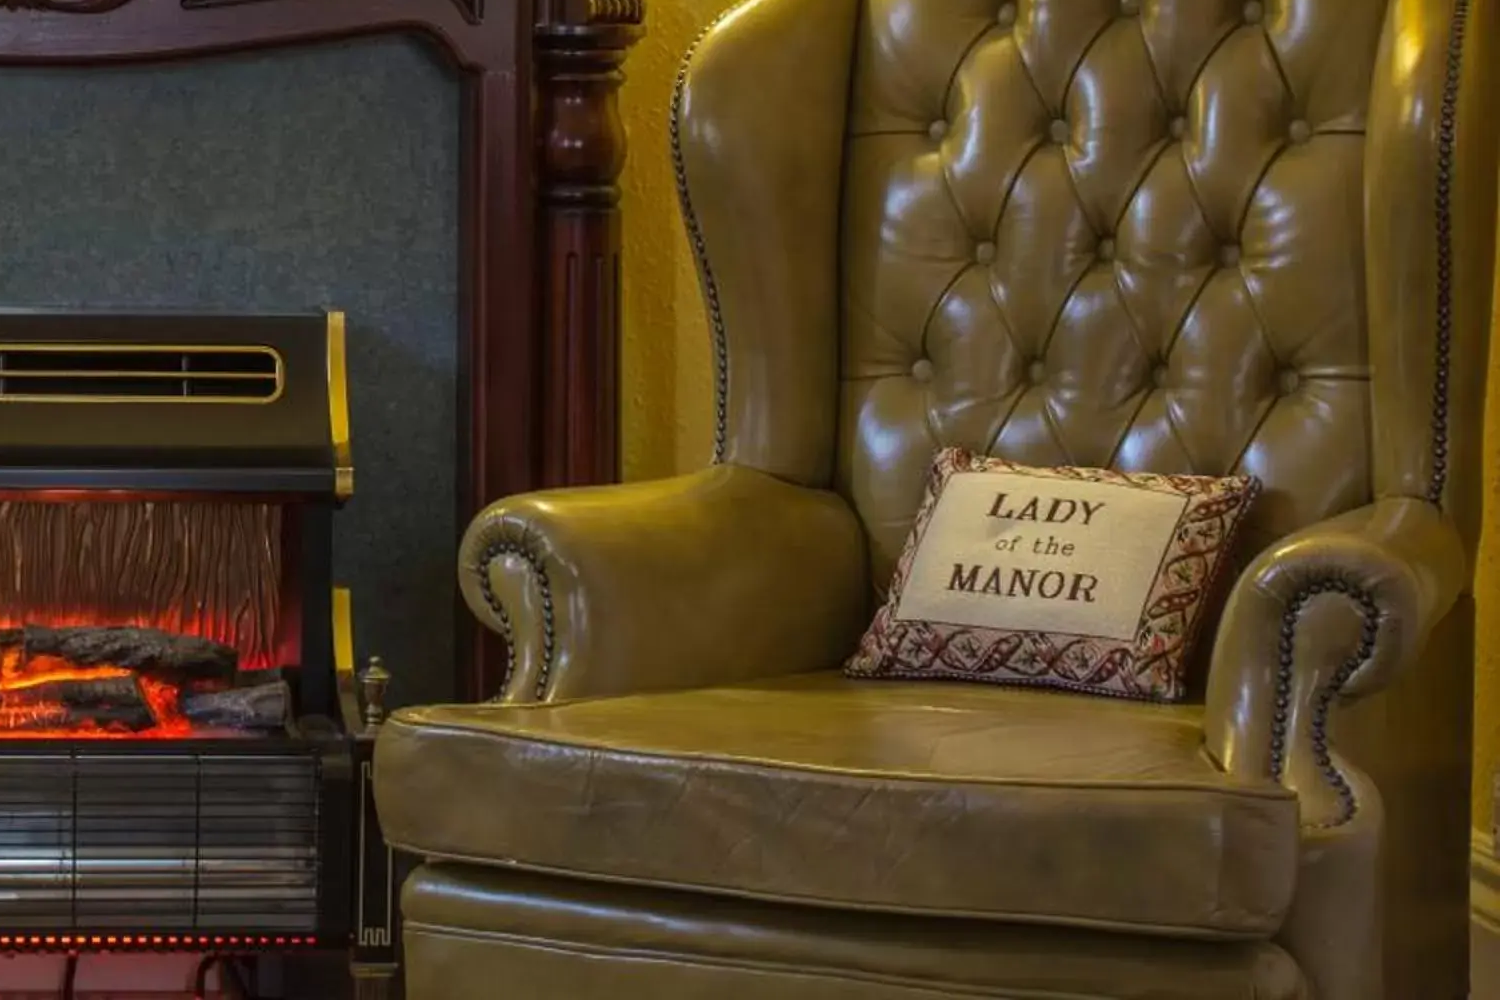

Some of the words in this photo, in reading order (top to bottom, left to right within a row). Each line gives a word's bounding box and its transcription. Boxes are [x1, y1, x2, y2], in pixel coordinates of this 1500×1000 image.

[986, 493, 1105, 525] LADY
[994, 535, 1025, 554] of
[1032, 535, 1075, 557] the
[947, 564, 1098, 602] MANOR
